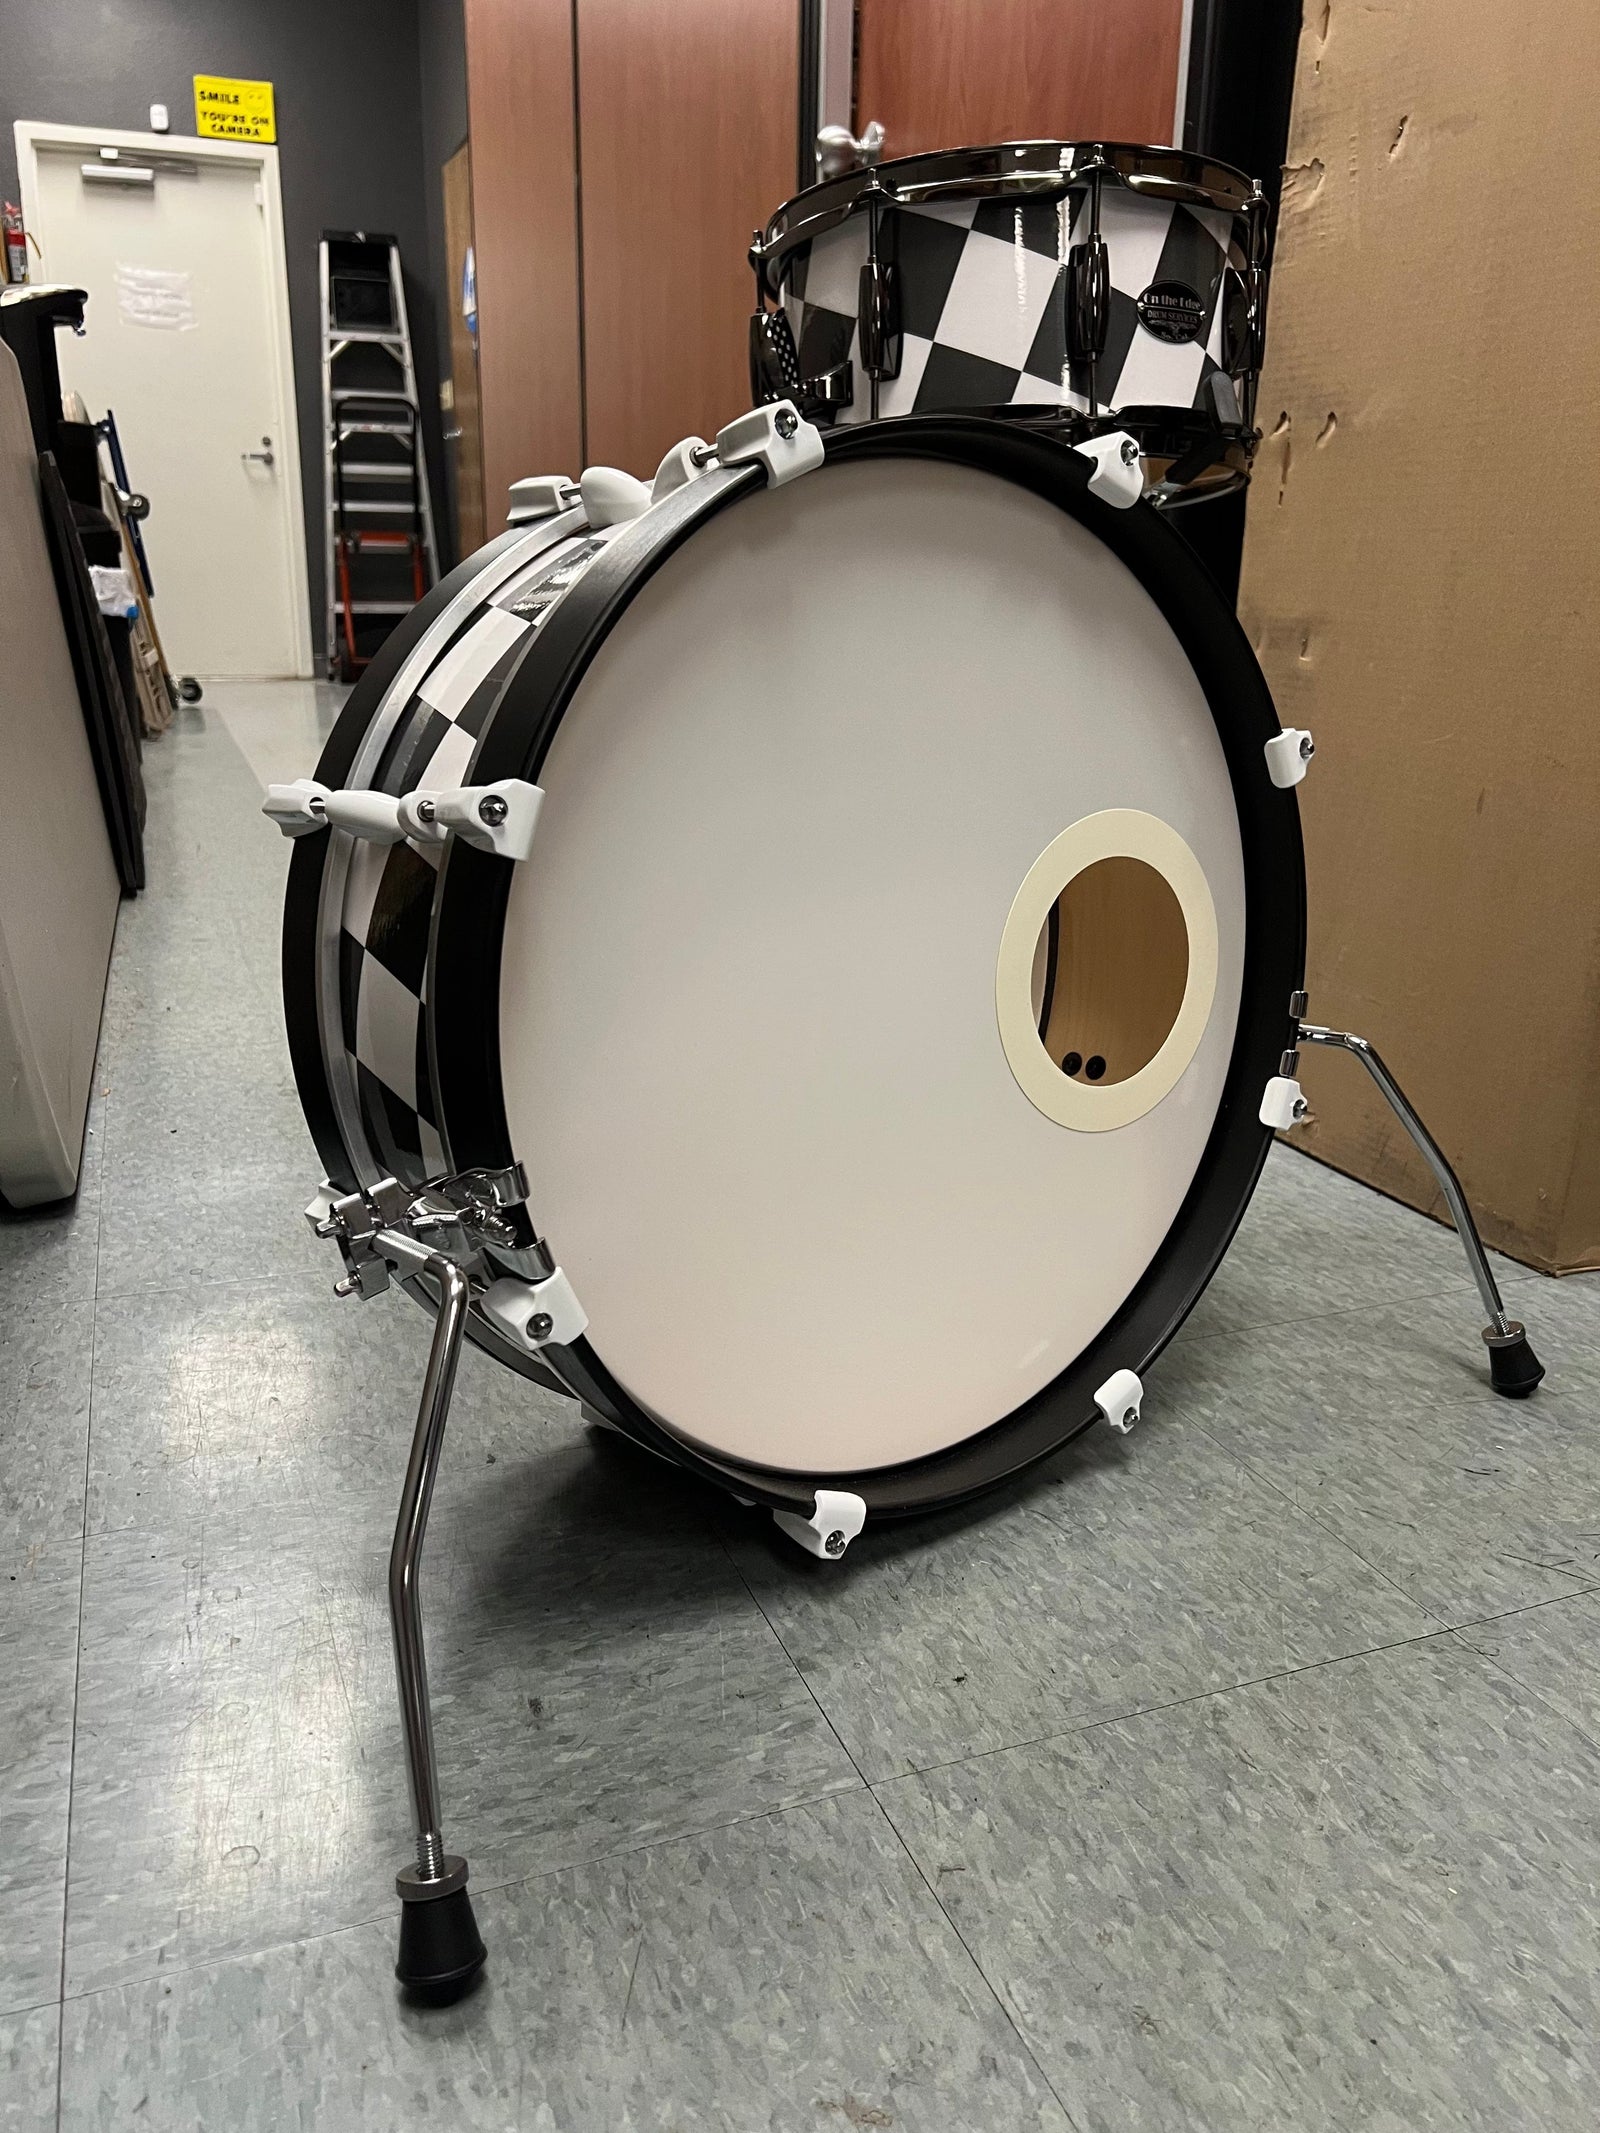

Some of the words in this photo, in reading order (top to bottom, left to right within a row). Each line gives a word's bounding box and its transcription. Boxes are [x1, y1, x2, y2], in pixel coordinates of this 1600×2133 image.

[200, 90, 240, 105] SMILE
[251, 116, 270, 127] ON
[211, 123, 260, 137] CAMERA
[1143, 292, 1159, 304] On
[1161, 294, 1178, 306] the
[1147, 309, 1167, 319] DRUM
[1168, 311, 1198, 324] SERVICES
